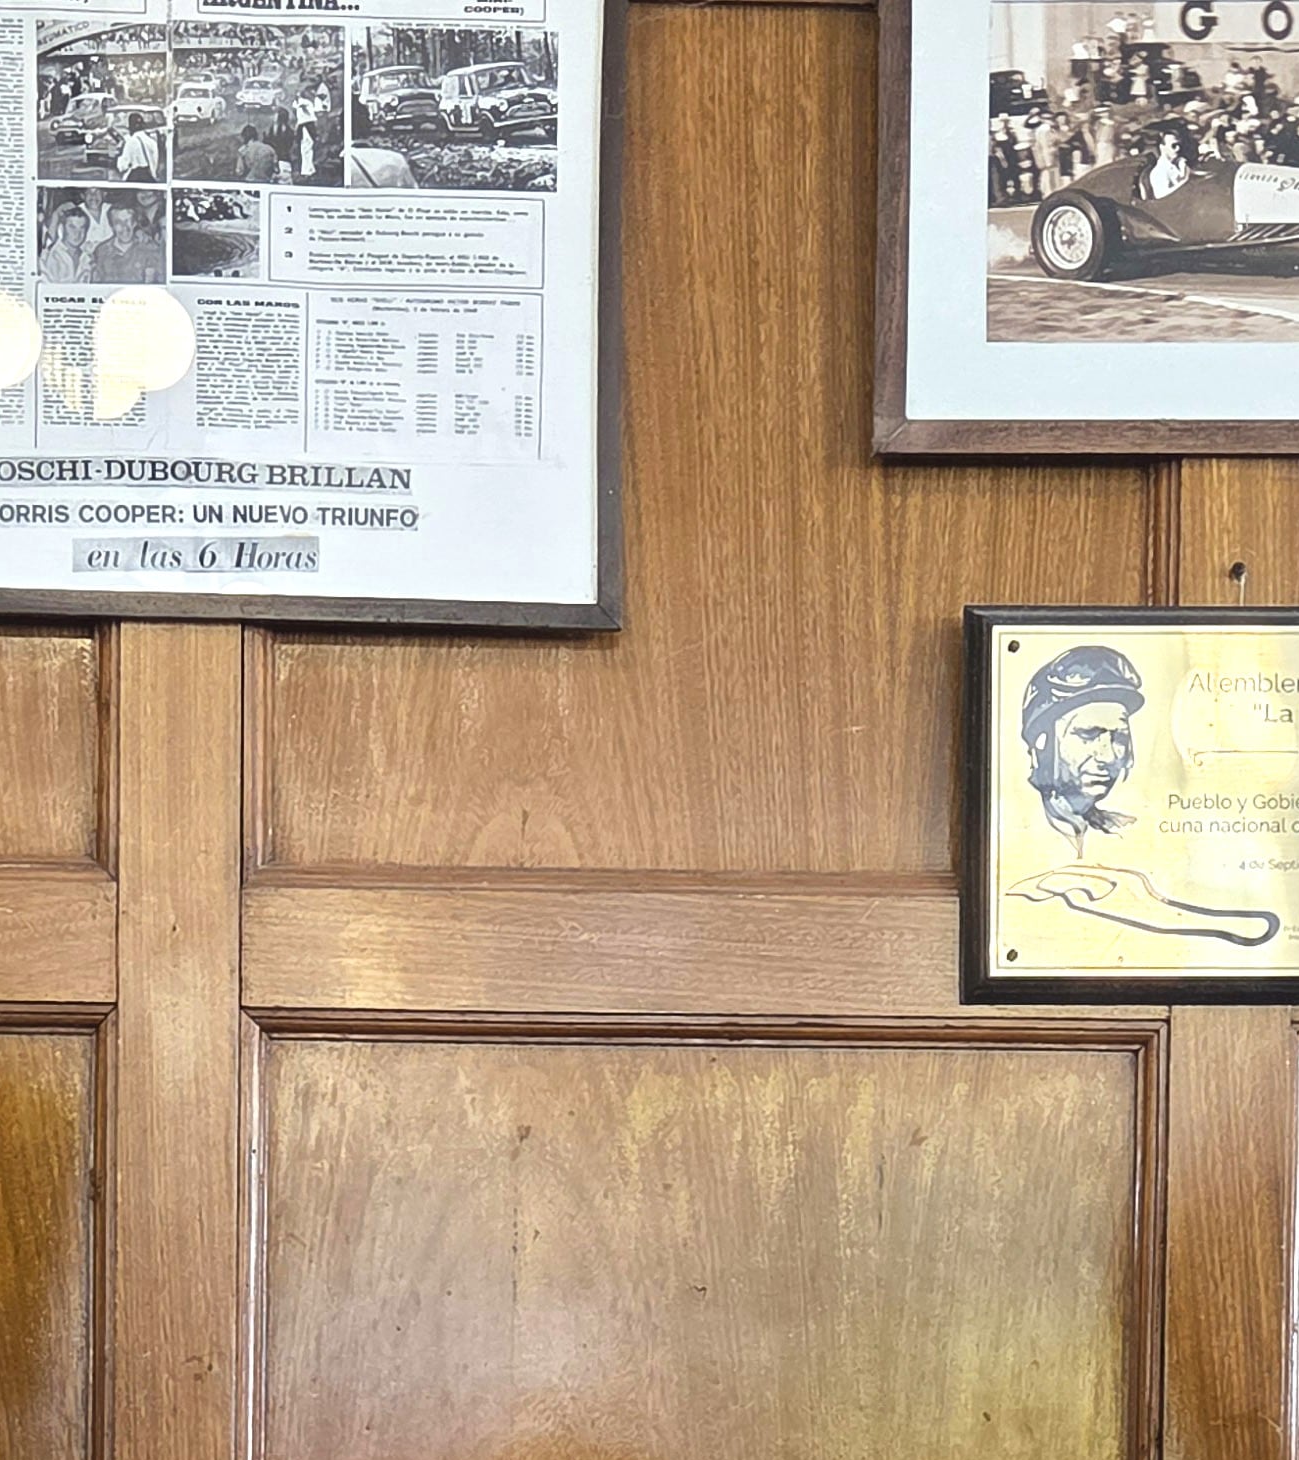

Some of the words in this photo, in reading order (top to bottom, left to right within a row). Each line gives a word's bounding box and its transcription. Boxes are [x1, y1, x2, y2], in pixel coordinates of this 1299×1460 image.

[464, 6, 524, 16] COOPER)
[44, 296, 86, 304] TOCAR
[265, 463, 412, 490] BRILLAN
[78, 504, 185, 524] COOPER:
[192, 504, 224, 524] UN
[232, 505, 308, 525] NUEVO
[317, 506, 419, 528] TRIUNFO
[87, 548, 120, 568] en
[140, 540, 182, 568] las
[199, 541, 217, 569] 6
[235, 542, 318, 570] Horas
[1189, 673, 1211, 693] Al
[1253, 704, 1294, 723] "La
[1168, 793, 1232, 810] Pueblo
[1237, 797, 1249, 814] y
[1158, 820, 1203, 834] cuna
[1209, 816, 1287, 834] nacional
[1239, 861, 1246, 870] 4
